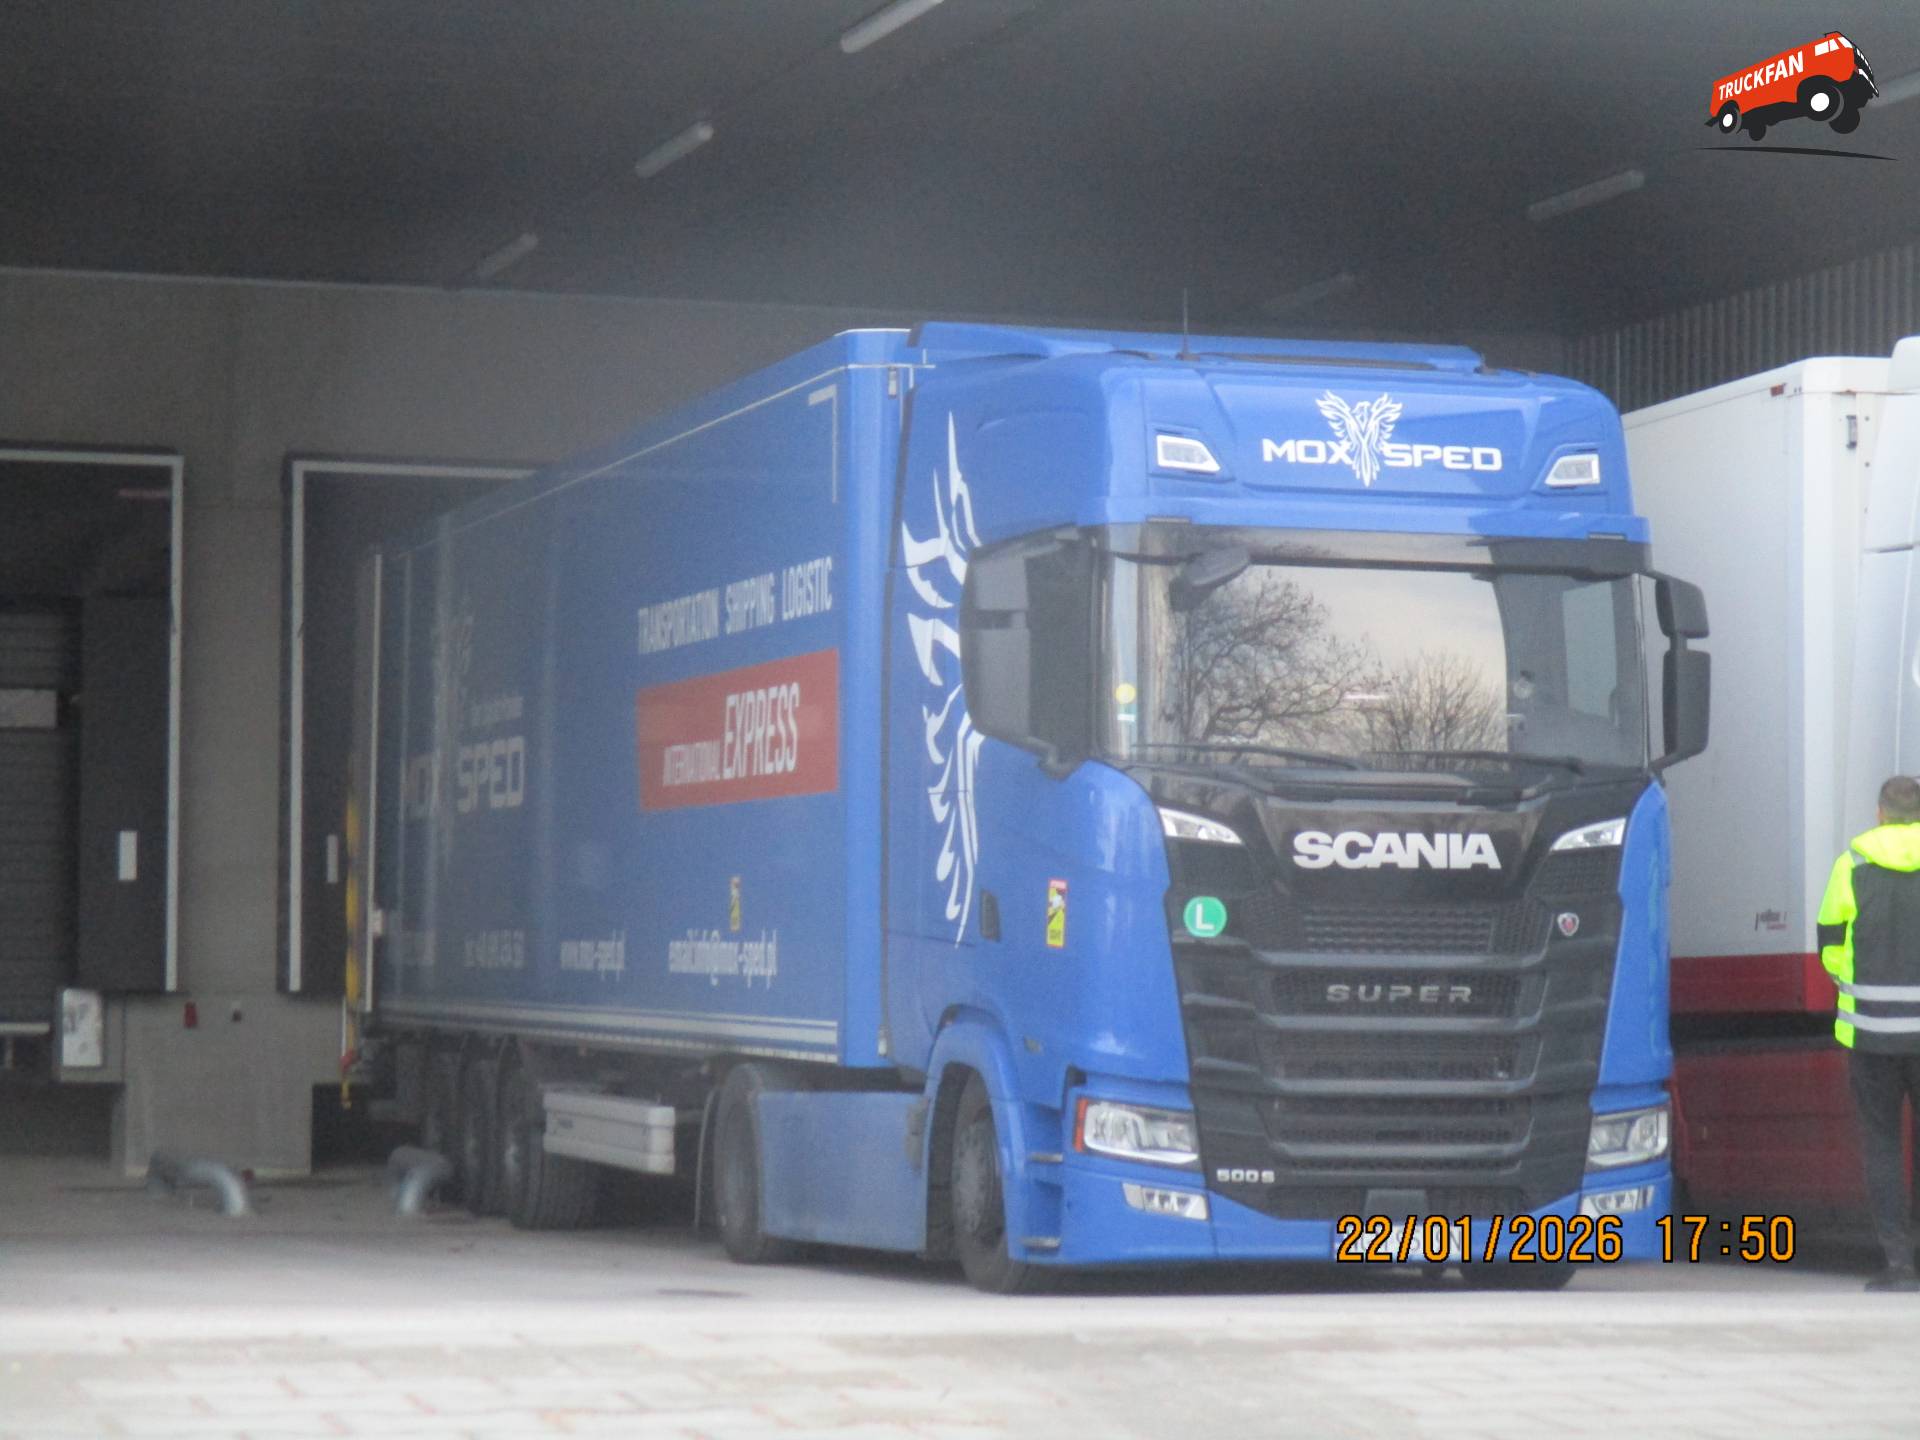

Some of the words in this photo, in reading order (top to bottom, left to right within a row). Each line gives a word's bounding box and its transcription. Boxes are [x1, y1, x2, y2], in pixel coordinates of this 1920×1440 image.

[1262, 438, 1353, 466] MOX
[1382, 443, 1503, 471] SPED
[725, 572, 776, 635] SHIPPING
[782, 556, 833, 621] LOGISTIC
[723, 682, 800, 780] EXPRESS
[1293, 831, 1501, 870] SCANIA
[1195, 903, 1214, 930] L
[1326, 984, 1473, 1003] SUPER
